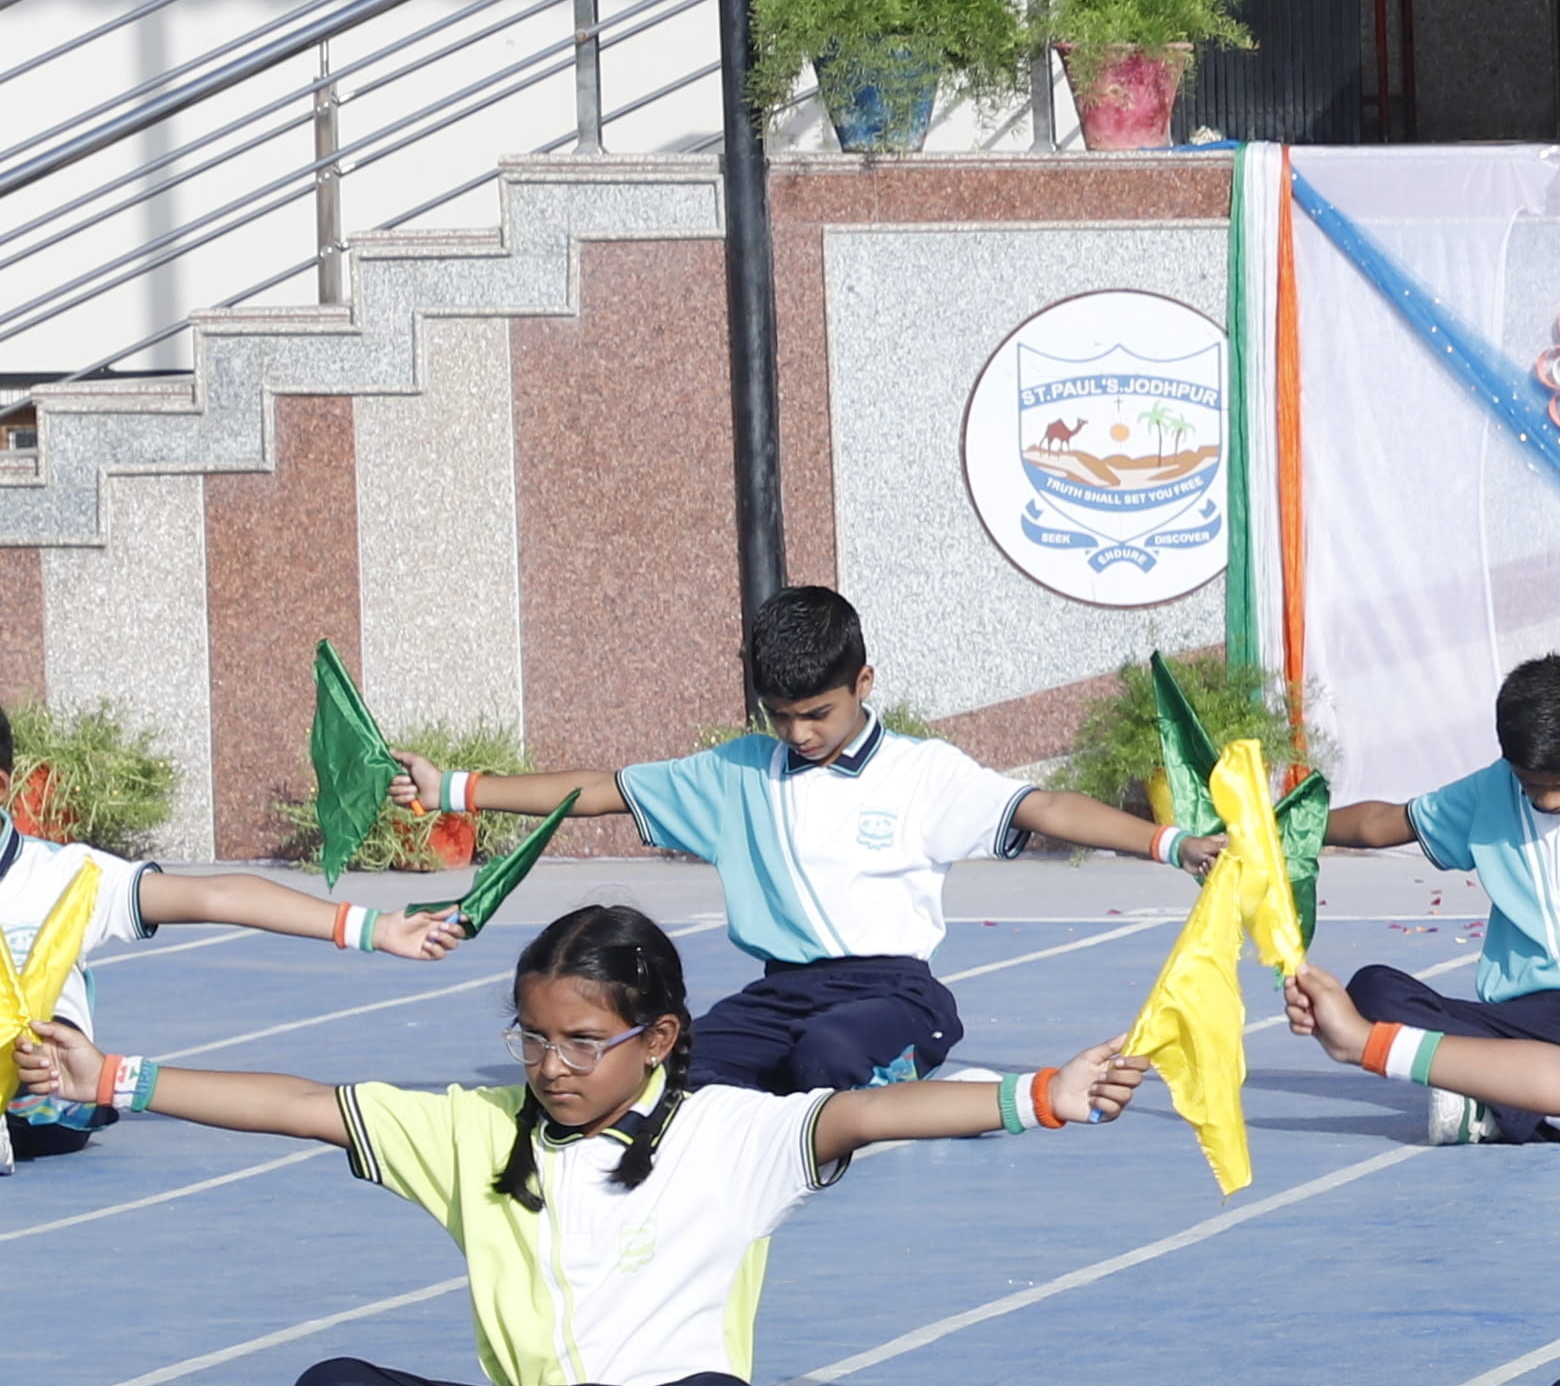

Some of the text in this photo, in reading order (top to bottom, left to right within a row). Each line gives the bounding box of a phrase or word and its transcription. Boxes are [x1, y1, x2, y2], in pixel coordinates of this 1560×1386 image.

[1045, 477, 1083, 500] TRUTH
[1084, 490, 1122, 506] SHALL
[1148, 486, 1174, 502] YOU
[1173, 475, 1204, 496] FREE
[1041, 532, 1072, 544] SEEK
[1154, 531, 1211, 546] DISCOVER
[1097, 549, 1148, 566] ENDURE
